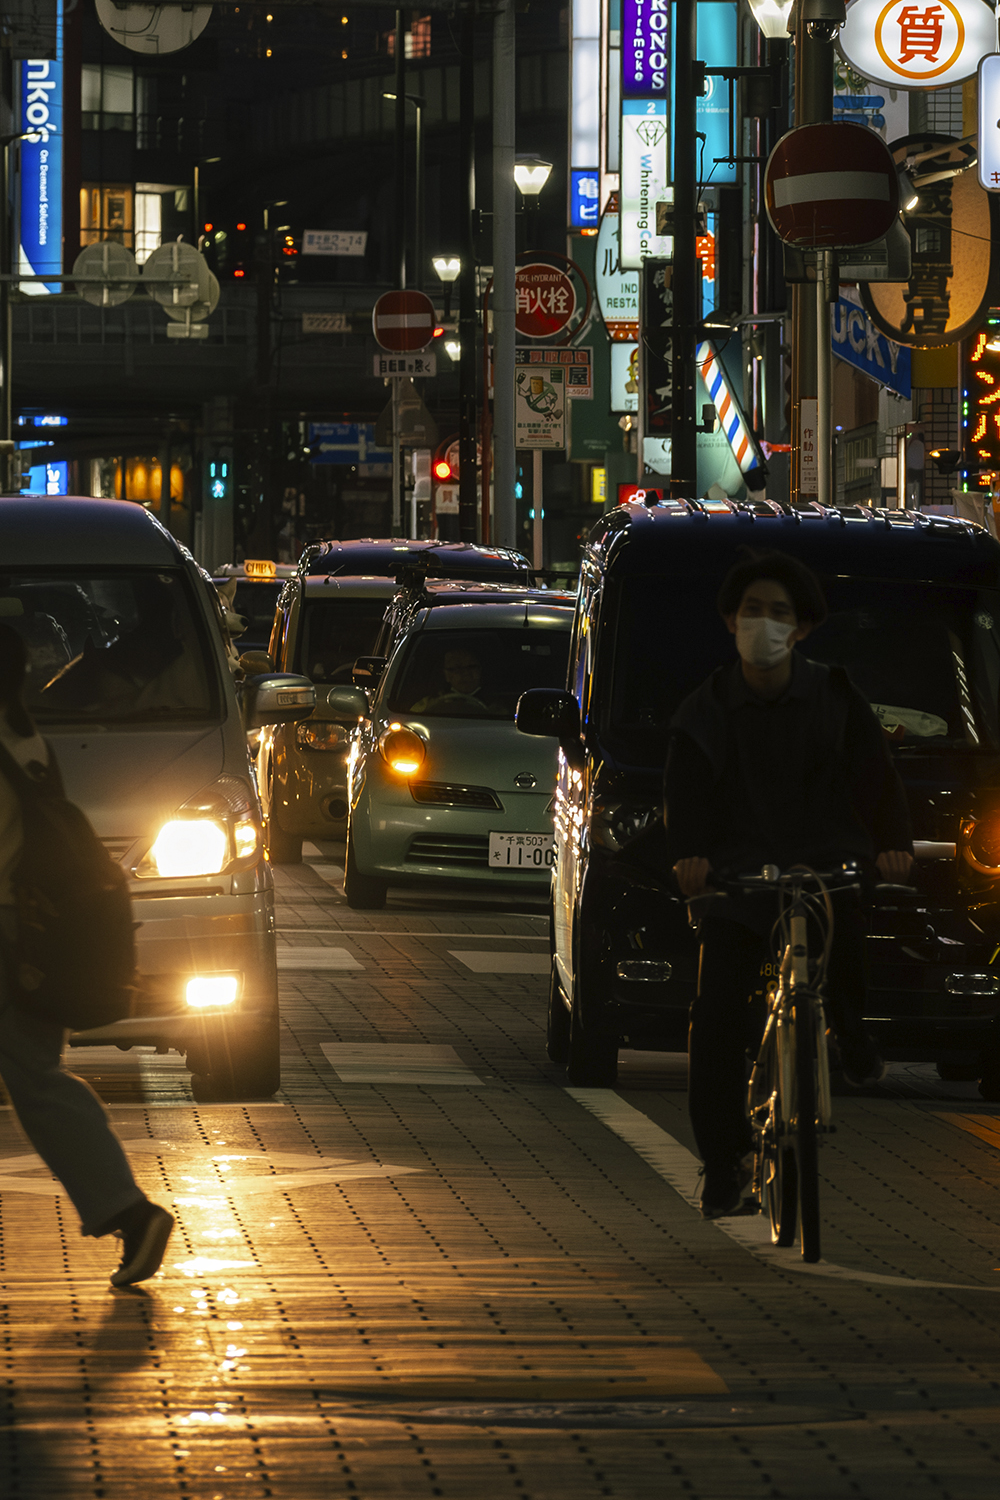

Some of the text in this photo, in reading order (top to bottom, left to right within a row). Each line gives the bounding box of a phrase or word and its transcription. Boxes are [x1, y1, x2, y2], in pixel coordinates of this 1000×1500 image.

[896, 4, 945, 65] 質
[39, 149, 49, 246] On Demand Solutions
[638, 154, 652, 229] Whitening
[515, 287, 569, 315] 消火栓
[507, 847, 554, 866] 11-00
[526, 836, 543, 846] 503
